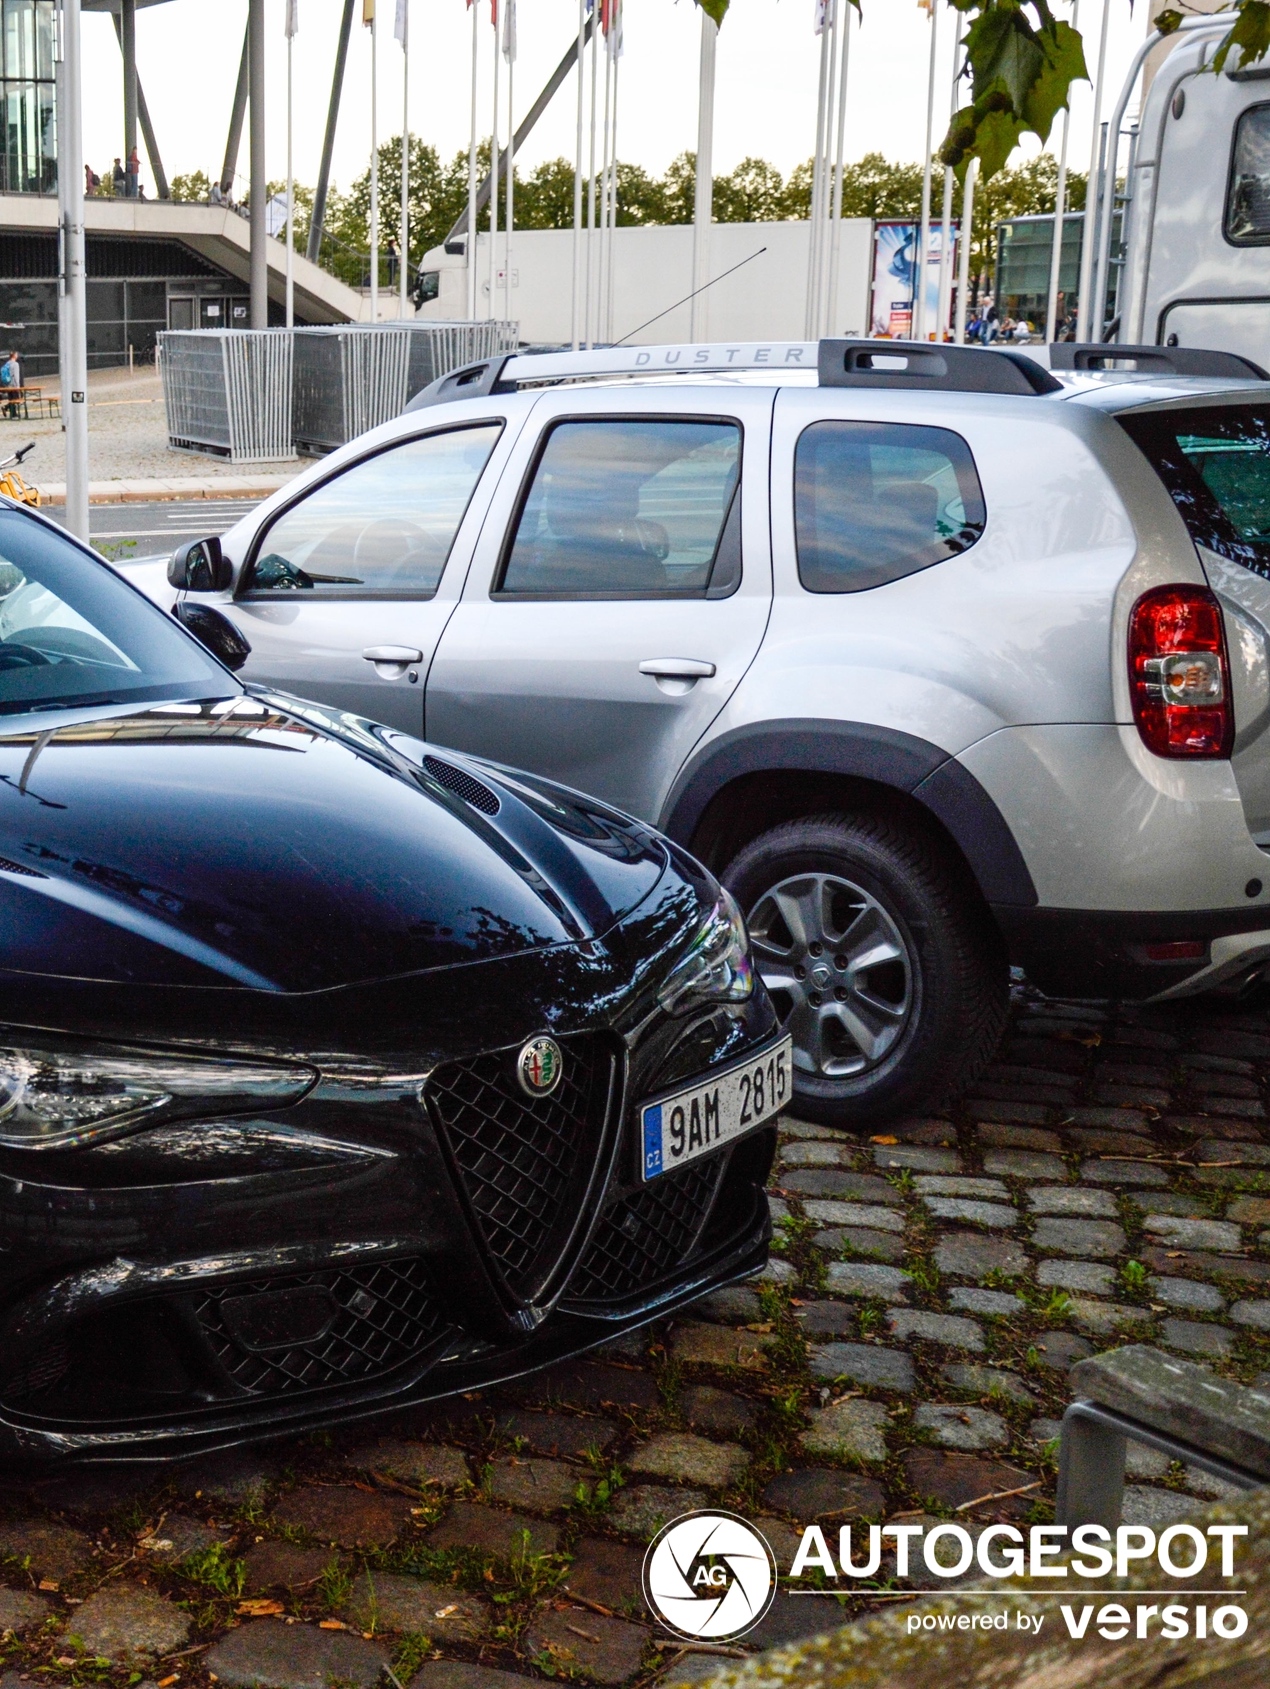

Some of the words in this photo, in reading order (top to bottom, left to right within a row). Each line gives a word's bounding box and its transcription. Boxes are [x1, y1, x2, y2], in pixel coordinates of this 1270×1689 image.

[635, 348, 804, 366] DUSTER
[670, 1088, 720, 1157] 9AM
[739, 1050, 786, 1126] 2815
[646, 1150, 661, 1169] CZ
